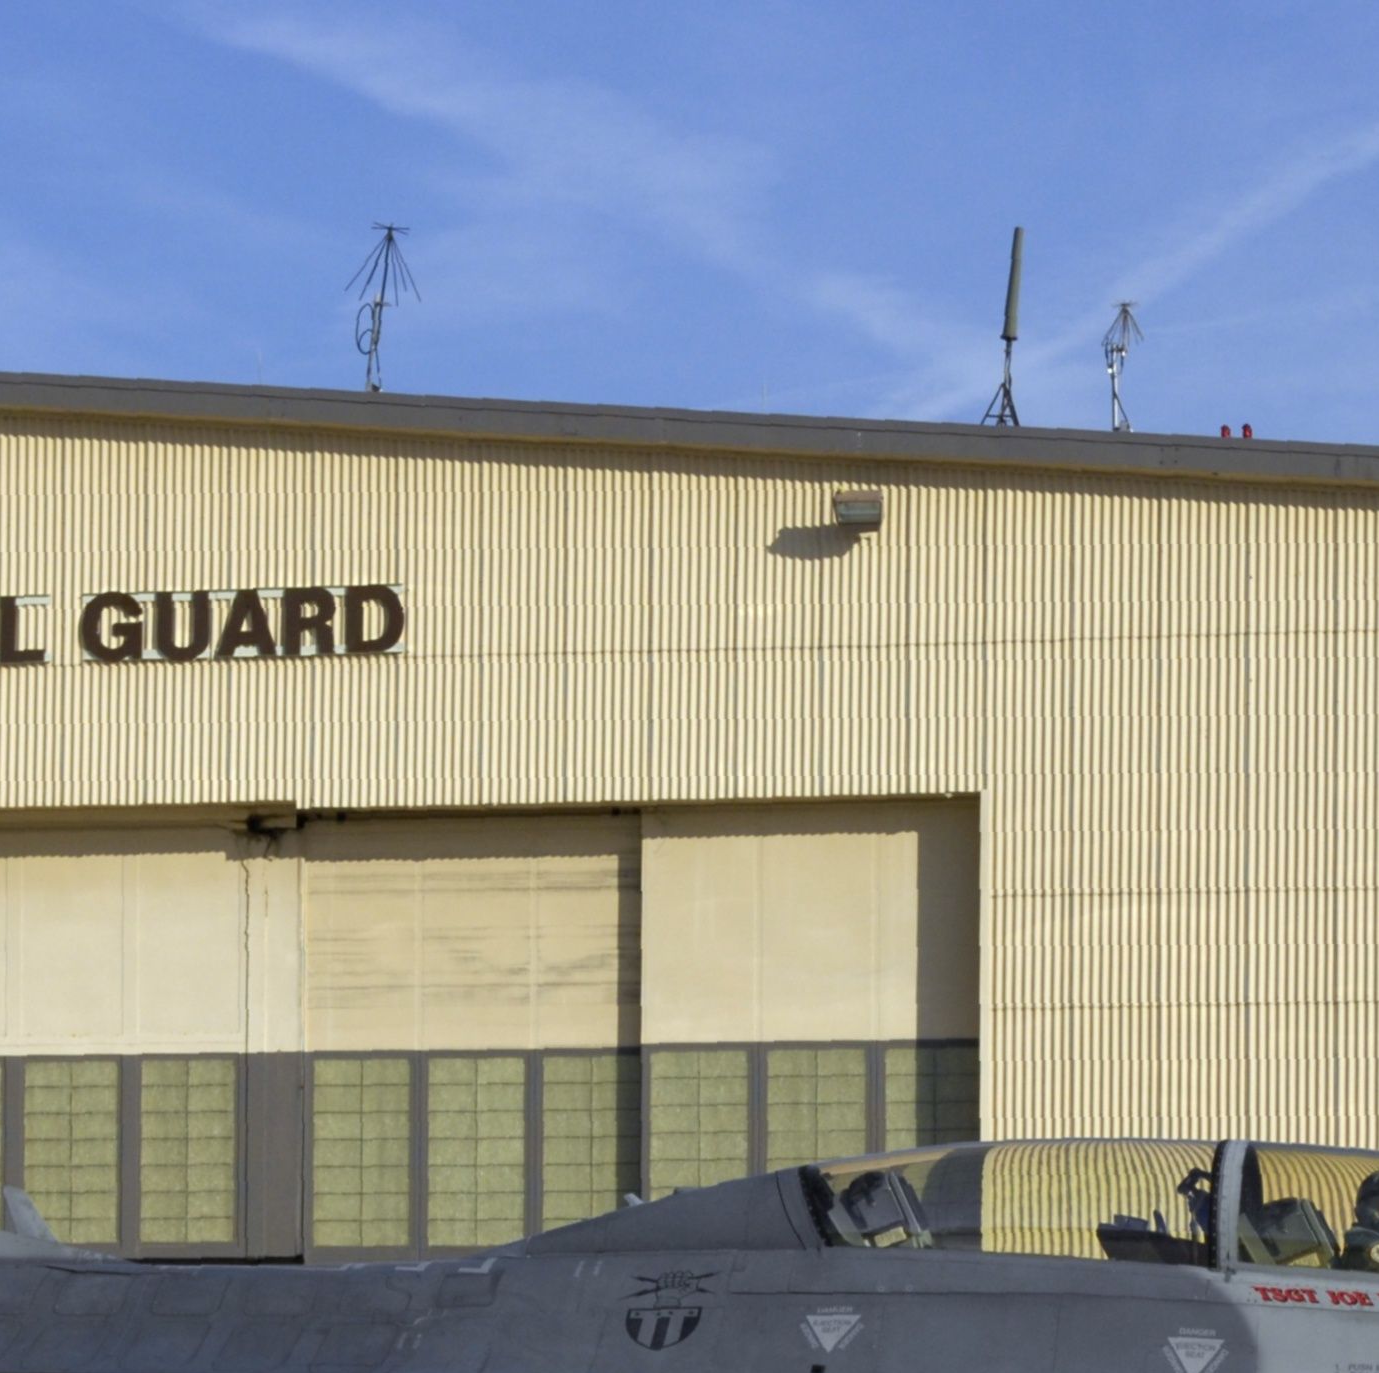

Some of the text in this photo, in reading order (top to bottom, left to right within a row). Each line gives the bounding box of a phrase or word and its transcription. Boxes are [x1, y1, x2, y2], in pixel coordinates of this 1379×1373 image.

[79, 583, 406, 662] GUARD
[1252, 1285, 1320, 1304] TSGT
[1326, 1289, 1374, 1307] JOE
[1179, 1327, 1217, 1337] DANGER
